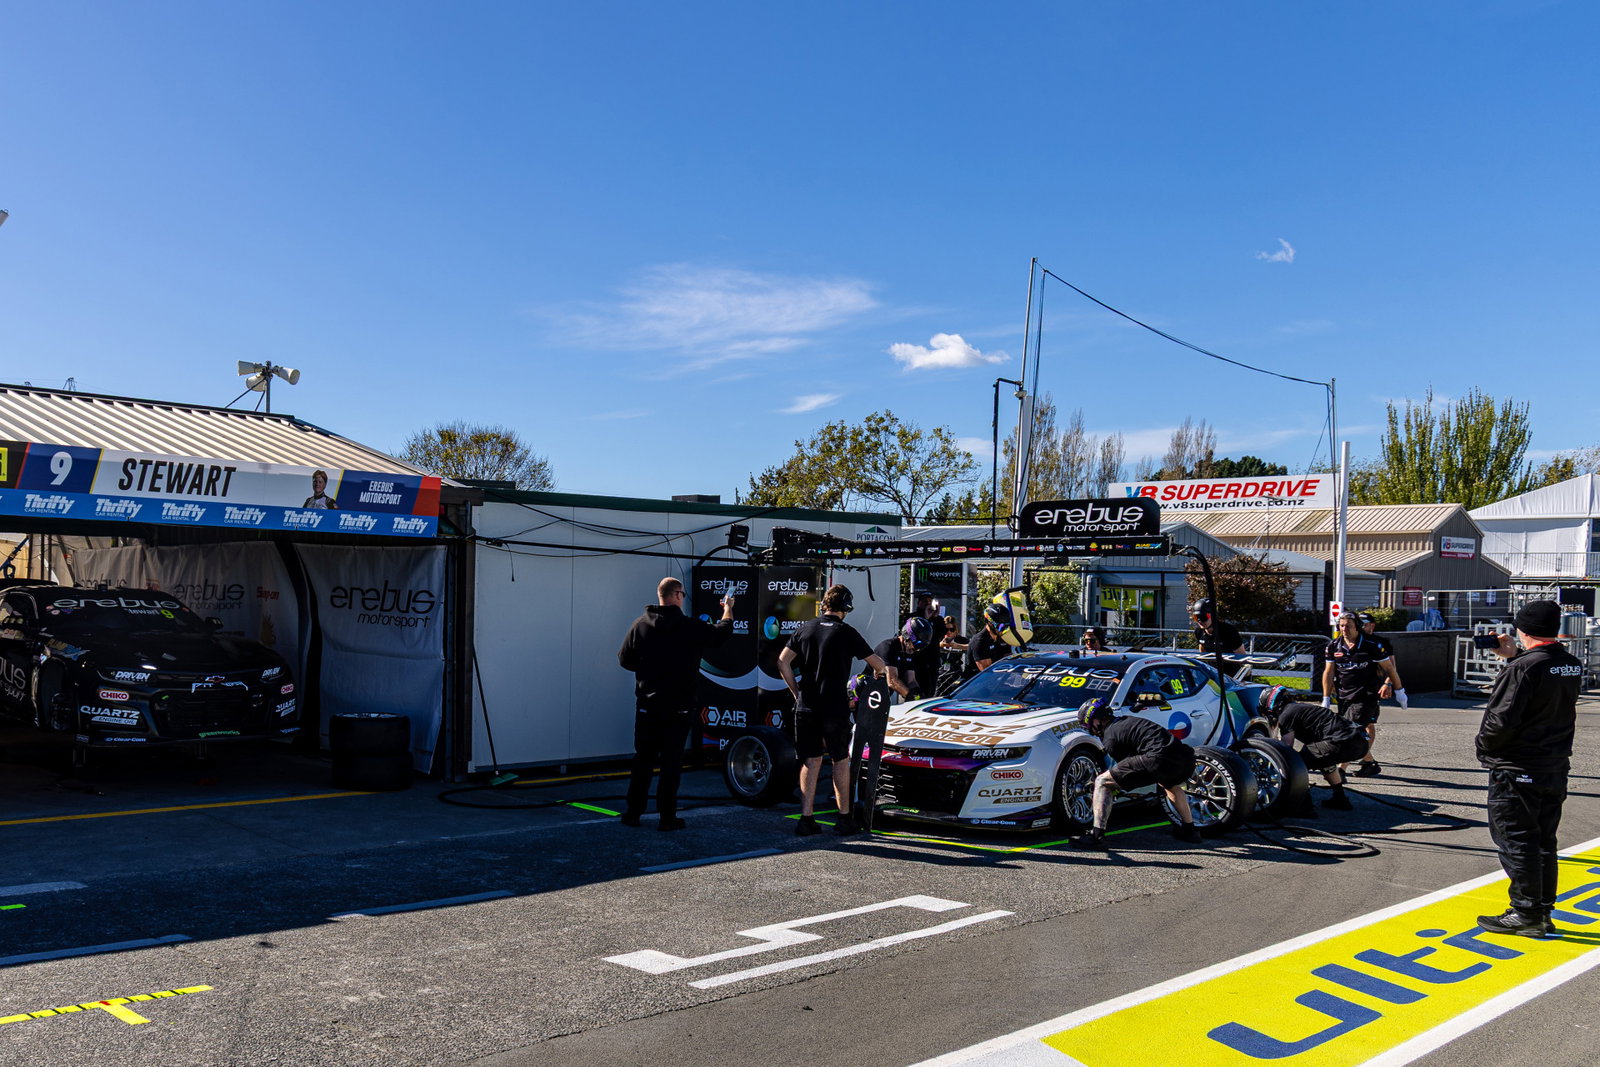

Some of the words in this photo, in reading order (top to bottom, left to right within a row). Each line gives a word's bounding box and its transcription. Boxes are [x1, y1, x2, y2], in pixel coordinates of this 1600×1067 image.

[50, 451, 73, 486] 9
[118, 457, 237, 498] STEWART
[369, 480, 394, 492] EREBUS
[359, 491, 402, 505] MOTORSPORT
[1125, 486, 1159, 499] V8
[1160, 479, 1321, 501] SUPERDRIVE
[25, 493, 75, 515] Thrifty
[96, 498, 143, 519] Thrifty
[162, 502, 206, 521] Thrifty
[224, 506, 267, 525] Thrifty
[283, 510, 323, 528] Thrifty
[339, 513, 377, 531] Thrifty
[1034, 503, 1144, 525] erebus
[392, 517, 429, 534] Thrifty
[1063, 522, 1140, 533] motorsport
[173, 579, 245, 601] erebus
[701, 577, 749, 591] erebus
[768, 578, 809, 592] erebus
[53, 597, 180, 609] erebus
[330, 580, 436, 615] erebus
[127, 608, 161, 616] tewart
[160, 609, 175, 619] 9
[356, 612, 431, 630] motorsport
[115, 670, 151, 680] DRIVEN
[992, 662, 1120, 680] erebus
[1550, 664, 1581, 675] erebus
[1059, 676, 1086, 688] 99
[1171, 678, 1185, 695] 99
[101, 690, 128, 700] CHIKO
[868, 690, 882, 709] e
[80, 705, 140, 719] QUARTZ
[98, 716, 123, 724] ENGINE
[721, 709, 747, 722] AIR
[893, 728, 960, 742] ENGINE
[962, 733, 993, 746] OIL
[972, 748, 1010, 758] DRIVEN
[992, 771, 1021, 779] CHIKO
[1210, 759, 1237, 797] DUNLOP
[977, 786, 1043, 798] QUARTZ
[980, 818, 1017, 826] Clear-Com
